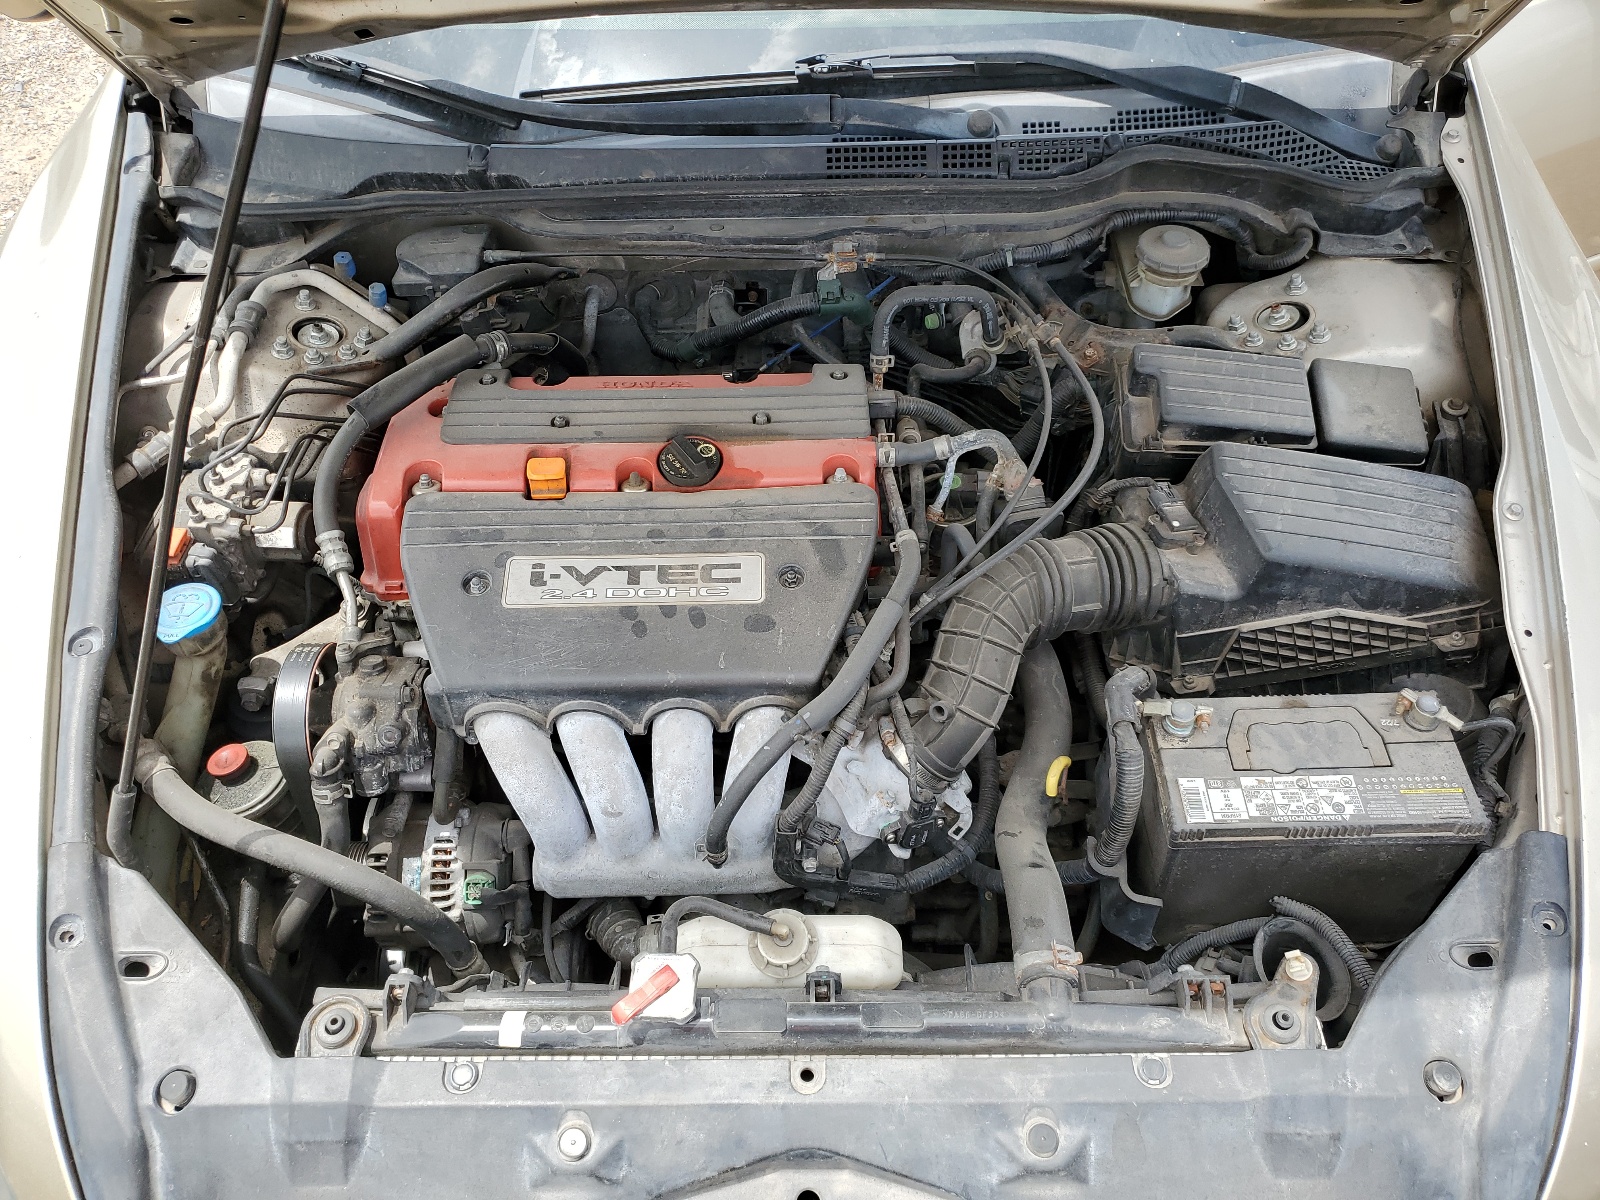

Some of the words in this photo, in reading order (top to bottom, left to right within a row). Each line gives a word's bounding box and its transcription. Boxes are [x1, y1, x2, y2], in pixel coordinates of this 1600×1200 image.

[529, 563, 742, 587] i-VTEC
[540, 587, 598, 599] 2.4
[605, 586, 730, 599] DOHC
